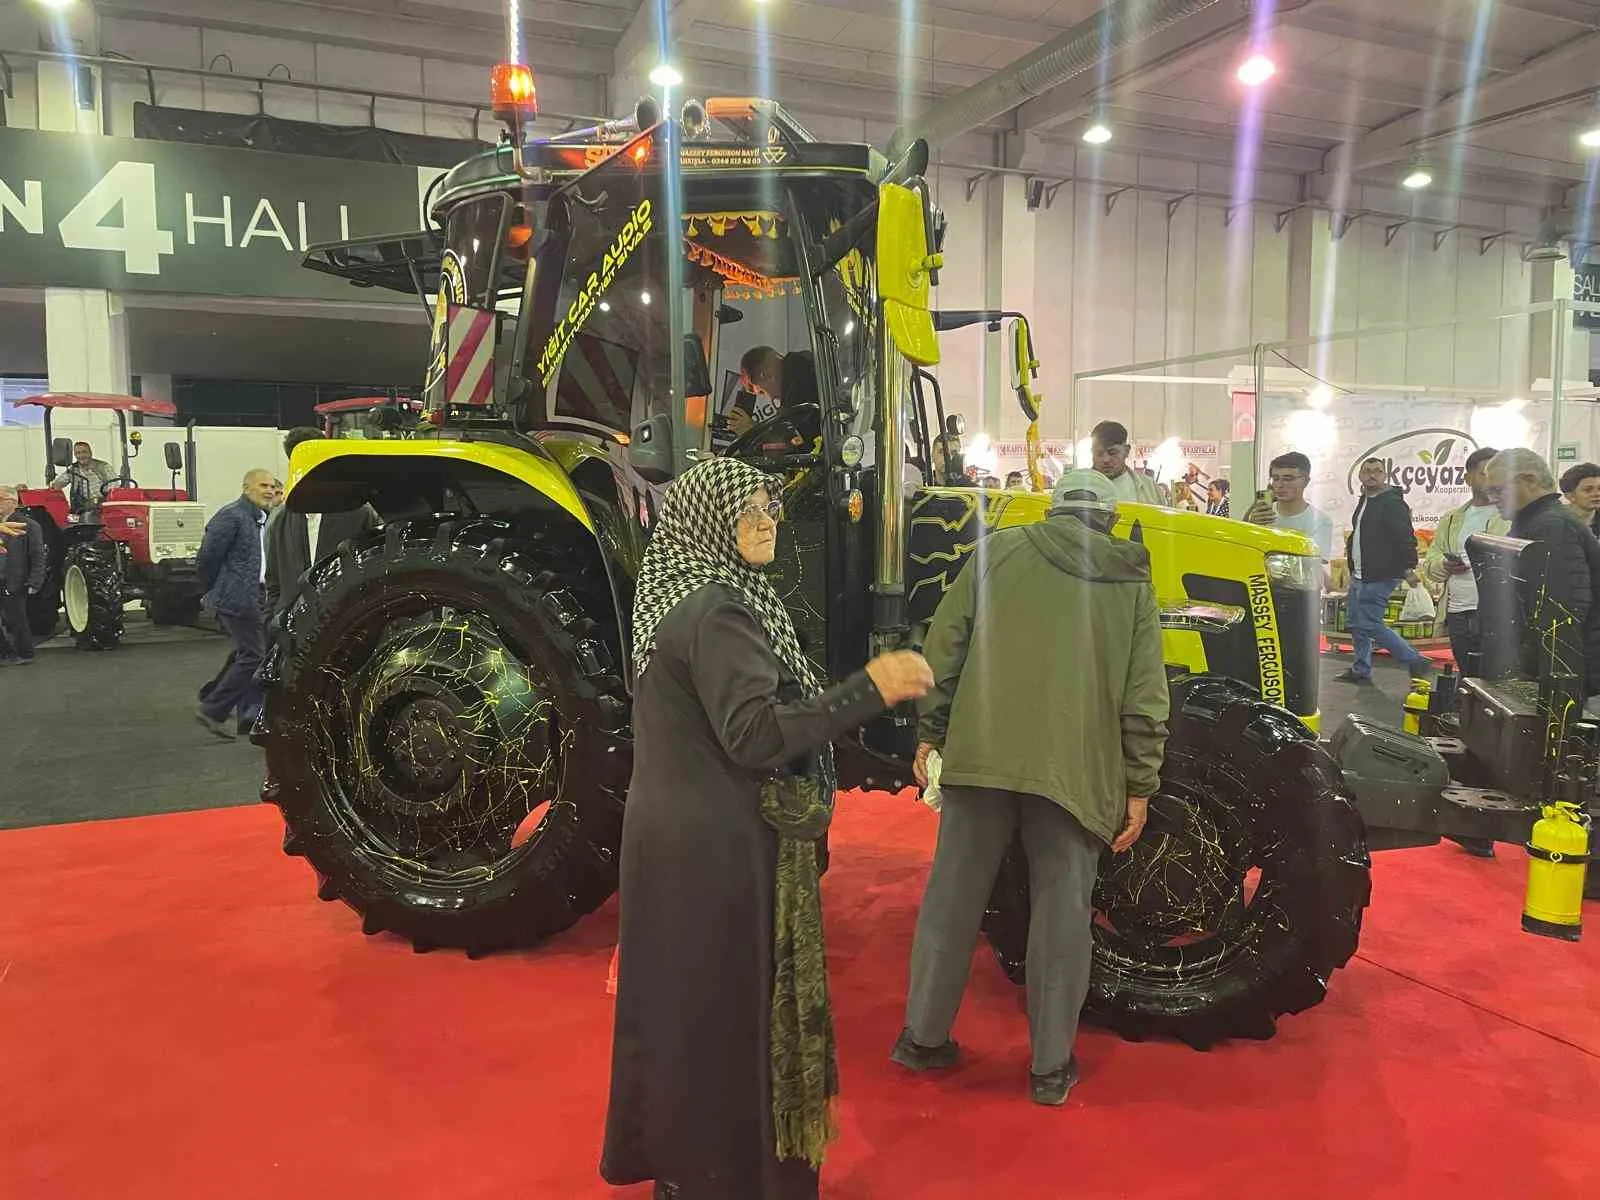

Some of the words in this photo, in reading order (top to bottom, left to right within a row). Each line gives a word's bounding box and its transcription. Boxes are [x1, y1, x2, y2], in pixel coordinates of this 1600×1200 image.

[58, 160, 174, 275] 4
[617, 218, 652, 269] SİVAS
[537, 319, 565, 374] YİĞİT
[568, 271, 599, 324] CAR
[602, 199, 651, 277] AUDİO
[1384, 457, 1466, 494] kçeyaz
[1248, 573, 1274, 631] MASSEY
